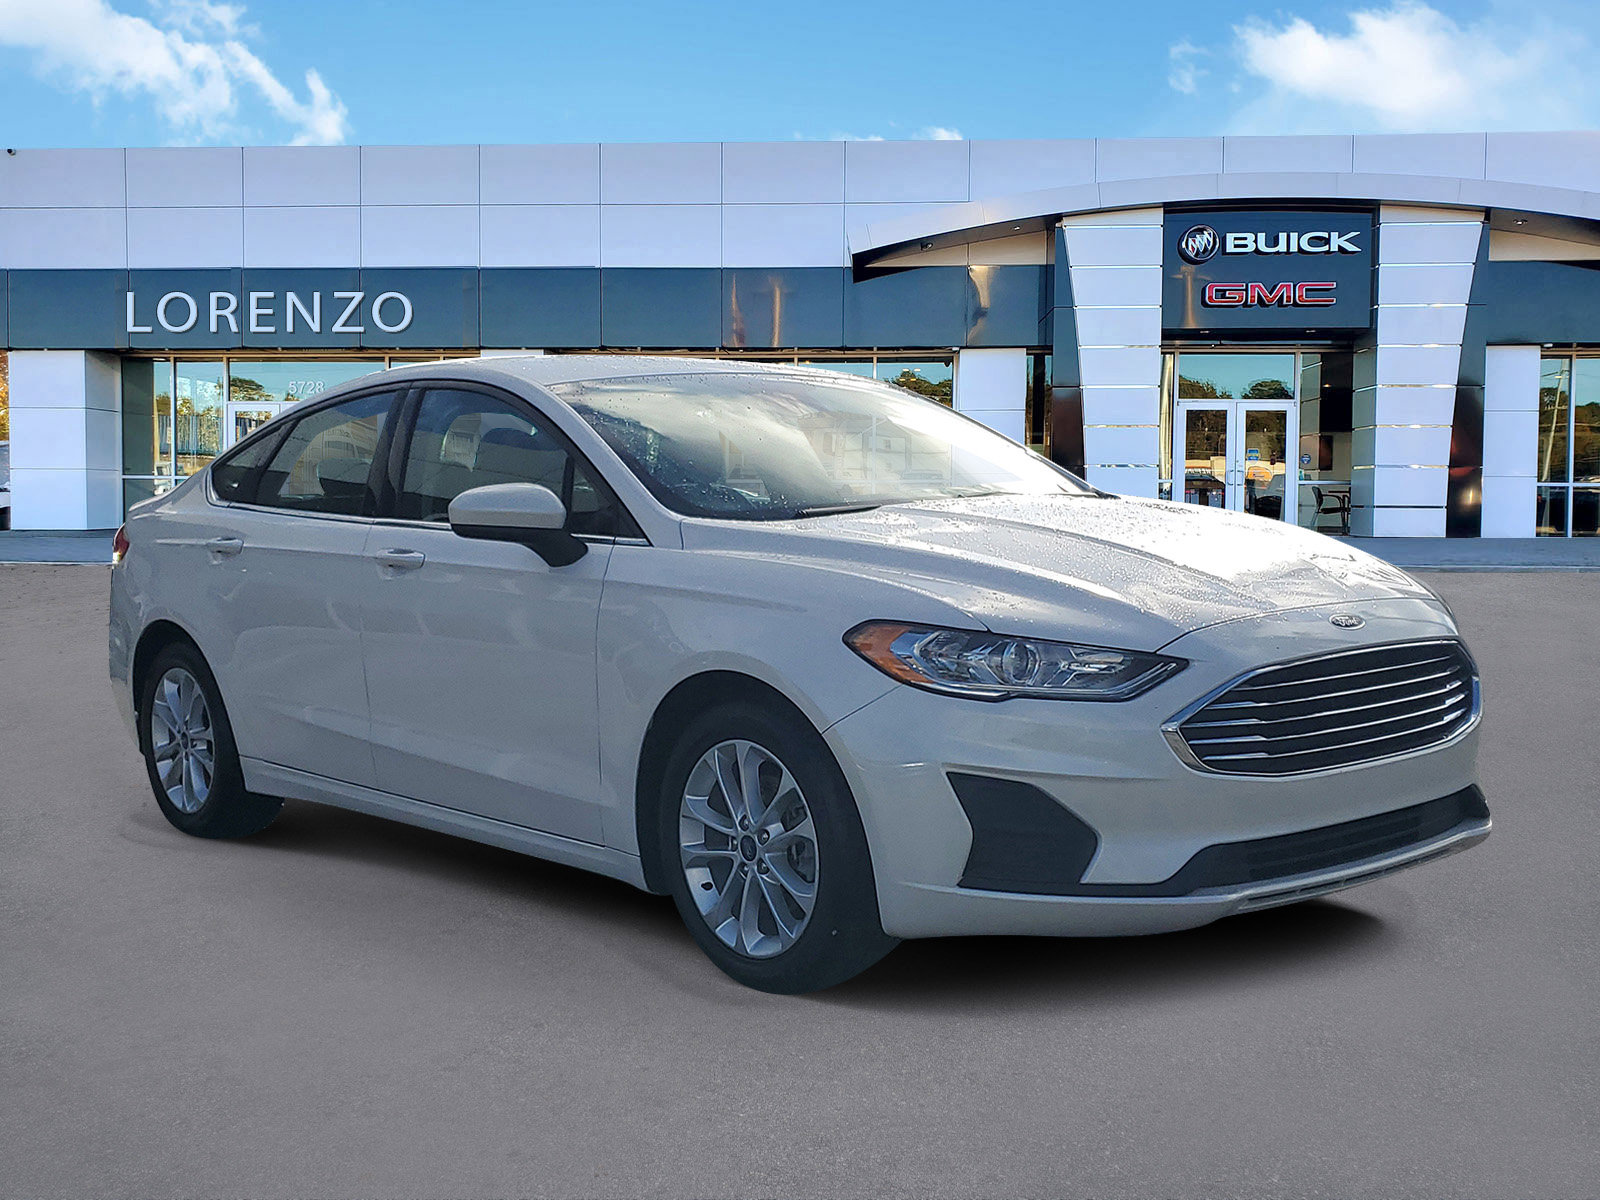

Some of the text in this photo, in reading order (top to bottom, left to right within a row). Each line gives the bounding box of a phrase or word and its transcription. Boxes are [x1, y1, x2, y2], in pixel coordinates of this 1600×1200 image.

[1224, 231, 1363, 254] BUICK
[1205, 281, 1337, 306] GMC
[126, 291, 414, 333] LORENZO
[288, 380, 325, 395] 5728
